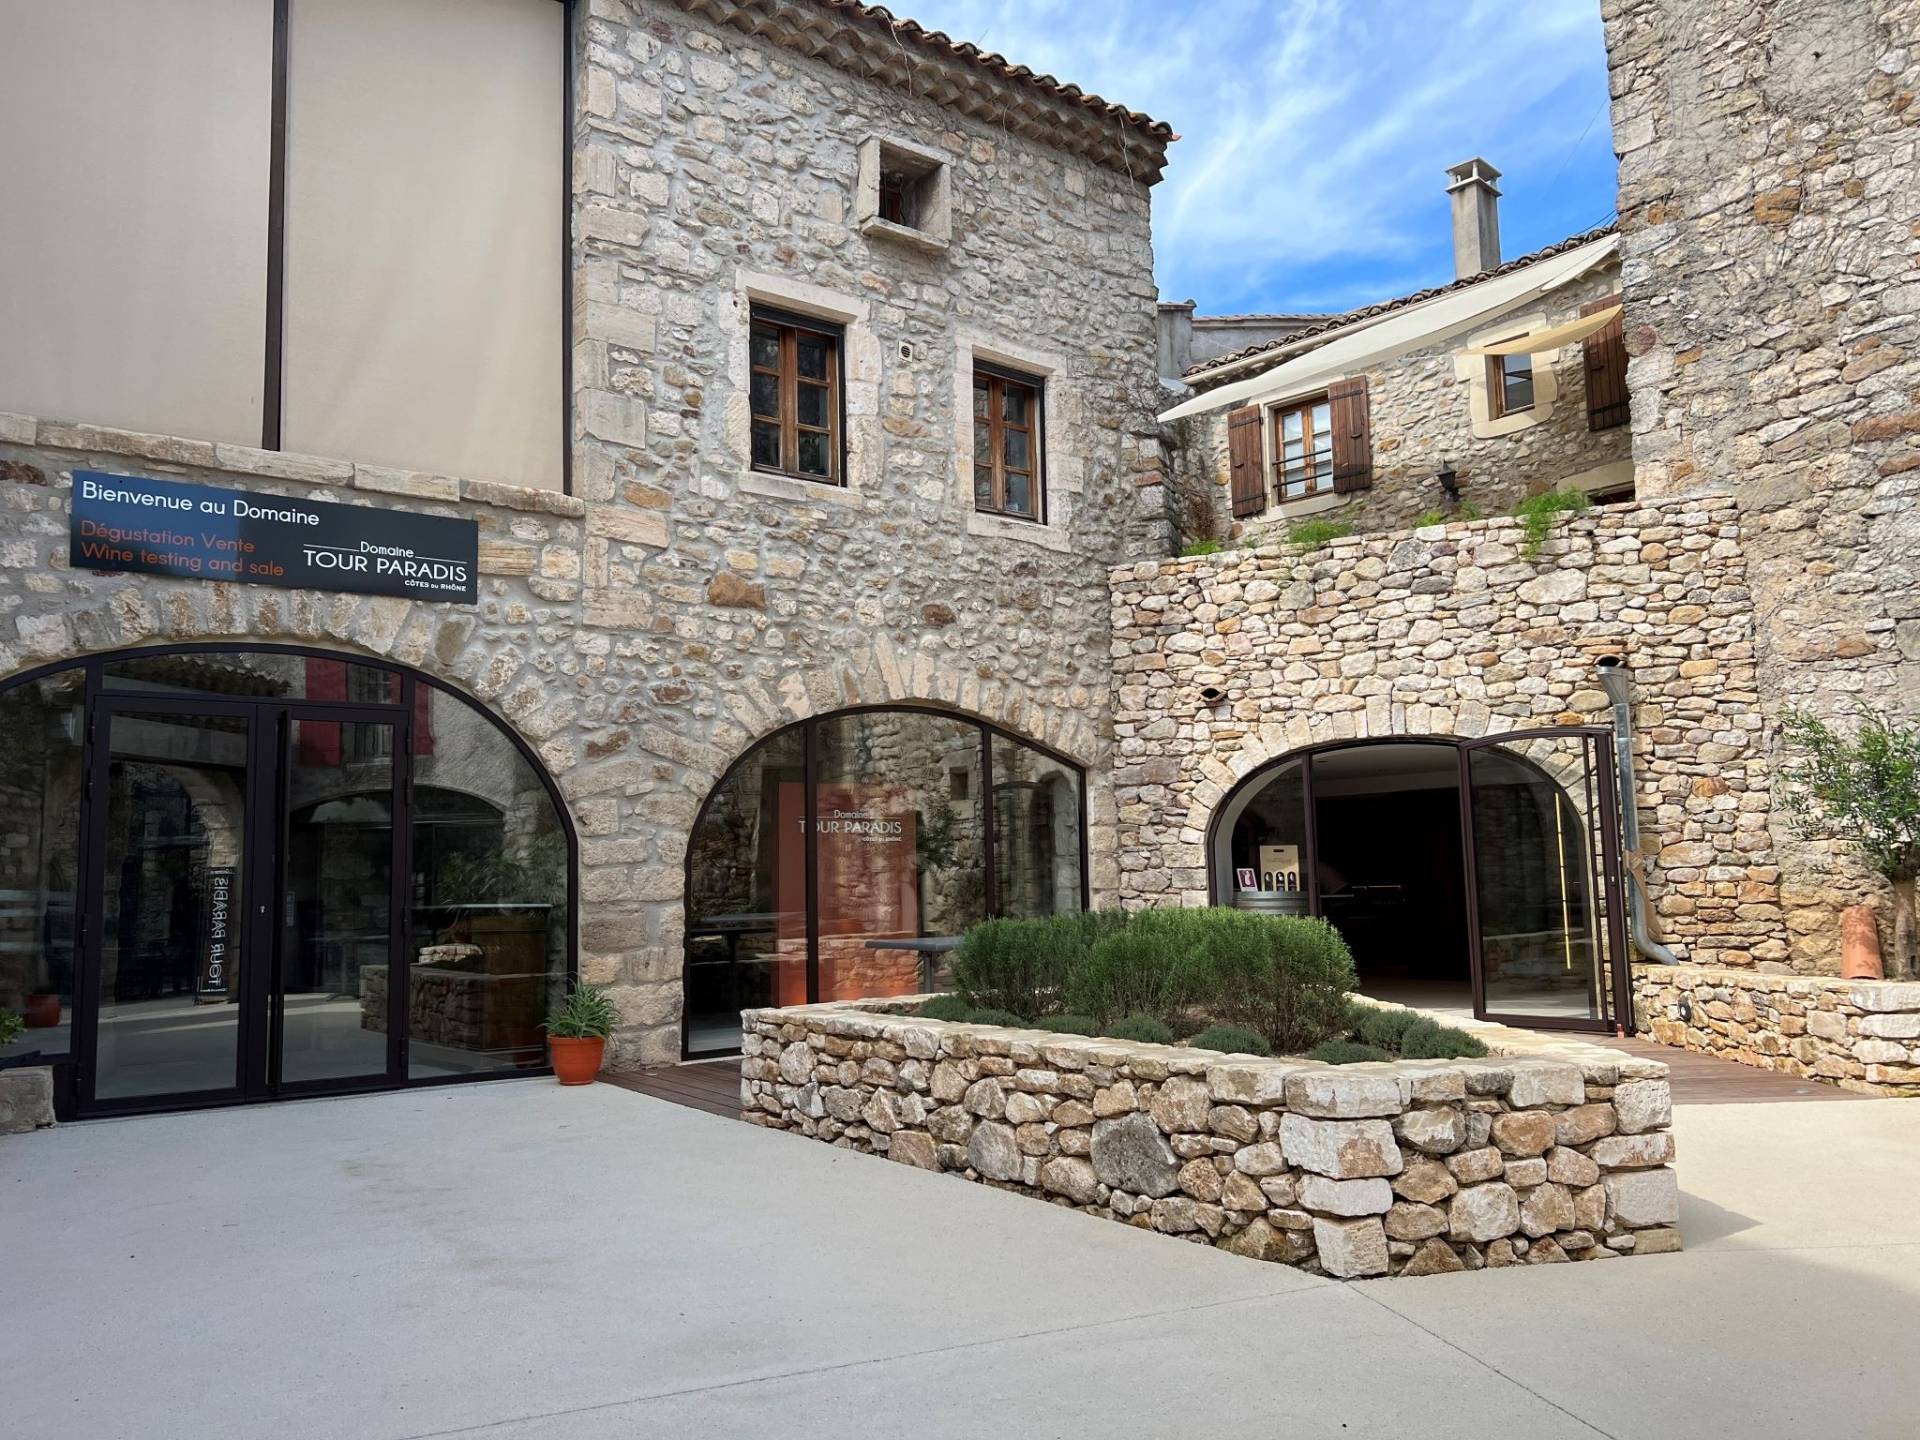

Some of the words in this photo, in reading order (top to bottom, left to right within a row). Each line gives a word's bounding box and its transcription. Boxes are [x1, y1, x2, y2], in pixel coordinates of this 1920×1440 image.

[82, 480, 193, 511] Bienvenue
[199, 501, 226, 515] au
[233, 499, 320, 526] Domaine
[80, 519, 195, 546] Dégustation
[201, 532, 256, 553] Vente
[360, 540, 415, 558] Domaine
[81, 542, 134, 562] Wine
[140, 549, 202, 572] testing
[208, 557, 244, 573] and
[248, 559, 286, 577] sale
[303, 549, 369, 573] TOUR
[376, 557, 468, 582] PARADIS
[404, 579, 429, 588] CÔTES
[440, 583, 467, 593] RHÔNE
[798, 820, 840, 834] TUR
[844, 820, 902, 834] PARADIS
